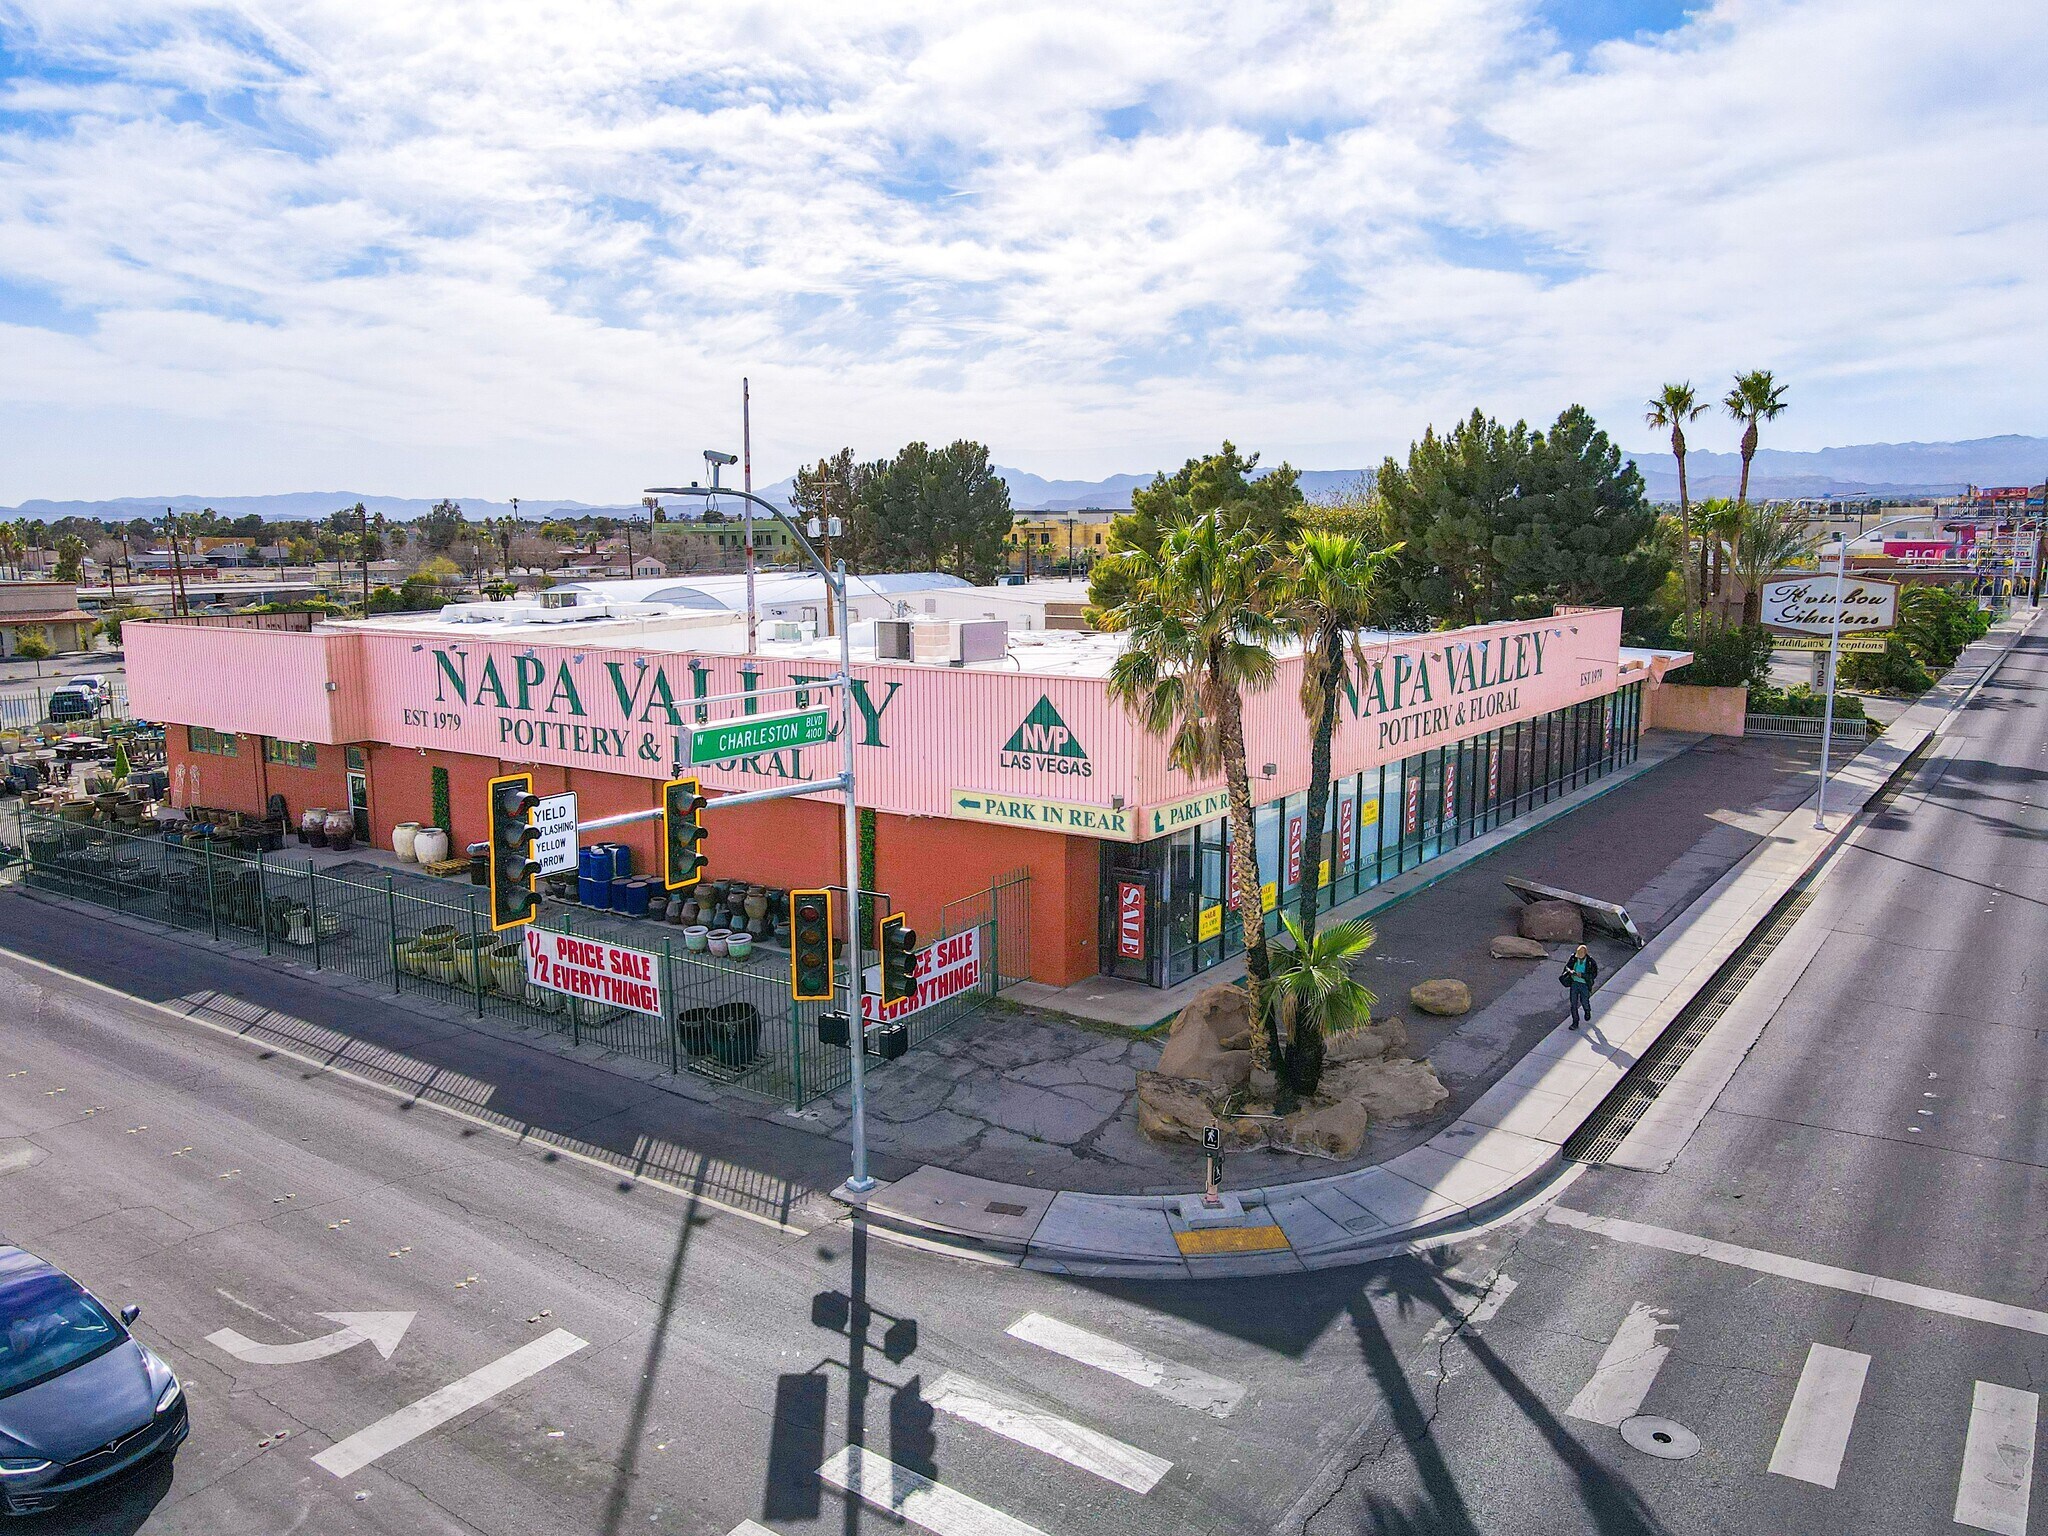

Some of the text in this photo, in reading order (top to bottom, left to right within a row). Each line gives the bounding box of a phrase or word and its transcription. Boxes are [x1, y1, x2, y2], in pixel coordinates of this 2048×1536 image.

[432, 650, 588, 716] NAPA
[1340, 630, 1551, 721] NAPA VALLEY
[1580, 672, 1591, 687] EST
[403, 708, 462, 731] EST 1979
[805, 715, 823, 728] BLVD
[805, 727, 822, 739] 4100
[1378, 687, 1521, 750] POTTERY & FLORAL
[498, 716, 631, 758] POTTERY
[637, 732, 663, 763] &
[697, 722, 799, 752] W CHARLESTON
[1021, 722, 1070, 753] NVP
[1000, 753, 1092, 778] LAS VEGAS
[534, 805, 567, 823] YIELD
[984, 798, 1126, 832] PARK IN REAR
[1170, 800, 1203, 825] PARK
[1205, 796, 1218, 815] IN
[1408, 779, 1416, 831] SALE
[536, 837, 566, 853] YELLOW
[540, 820, 574, 836] FLASHING
[1342, 802, 1350, 859] SALE
[539, 854, 565, 868] ARROW
[1289, 820, 1301, 881] SALE
[1122, 886, 1141, 955] SALE
[527, 930, 550, 983] 1/2
[556, 936, 651, 981] PRICE SALE
[937, 932, 973, 969] SALE
[552, 963, 659, 1012] EVERYTHING!
